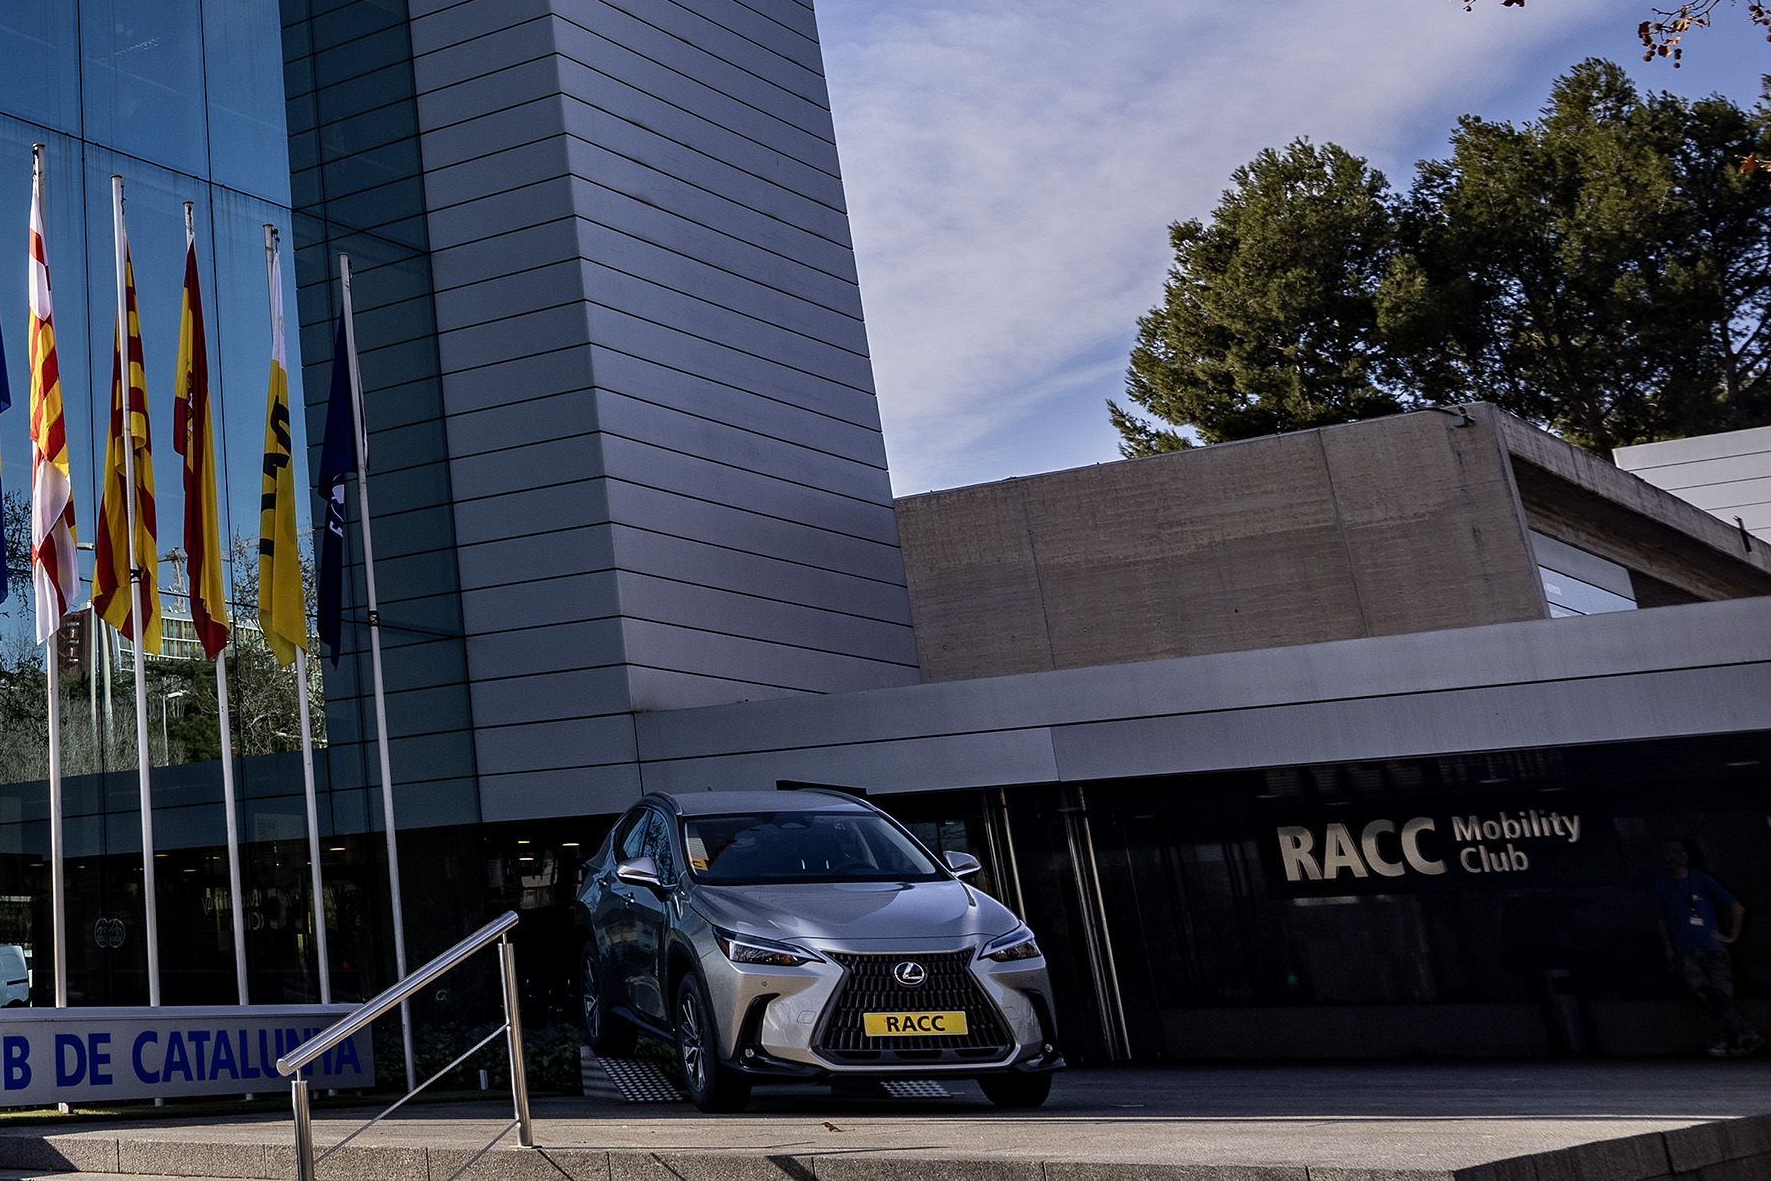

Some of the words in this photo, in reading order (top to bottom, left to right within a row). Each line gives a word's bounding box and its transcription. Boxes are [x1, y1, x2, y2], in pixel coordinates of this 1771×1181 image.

[1277, 816, 1447, 881] RACC
[1451, 809, 1580, 843] Mobility
[1459, 843, 1529, 874] Club
[885, 1015, 946, 1032] RACC
[55, 1032, 113, 1087] DE
